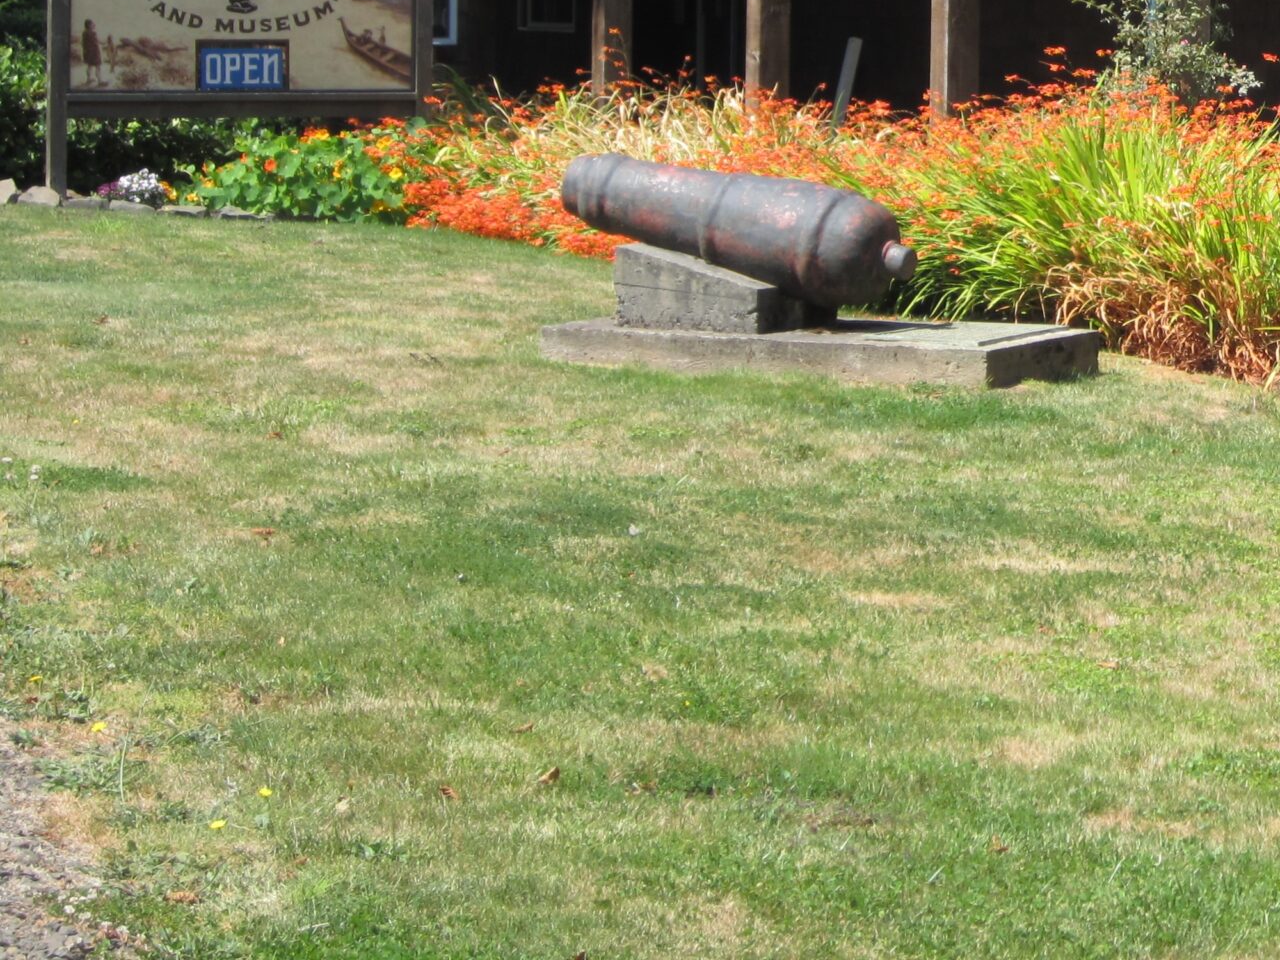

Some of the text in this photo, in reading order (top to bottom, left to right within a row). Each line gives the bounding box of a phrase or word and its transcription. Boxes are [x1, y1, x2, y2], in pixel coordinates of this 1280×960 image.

[151, 0, 334, 34] AND MUSEUM
[205, 53, 281, 85] OPEN
